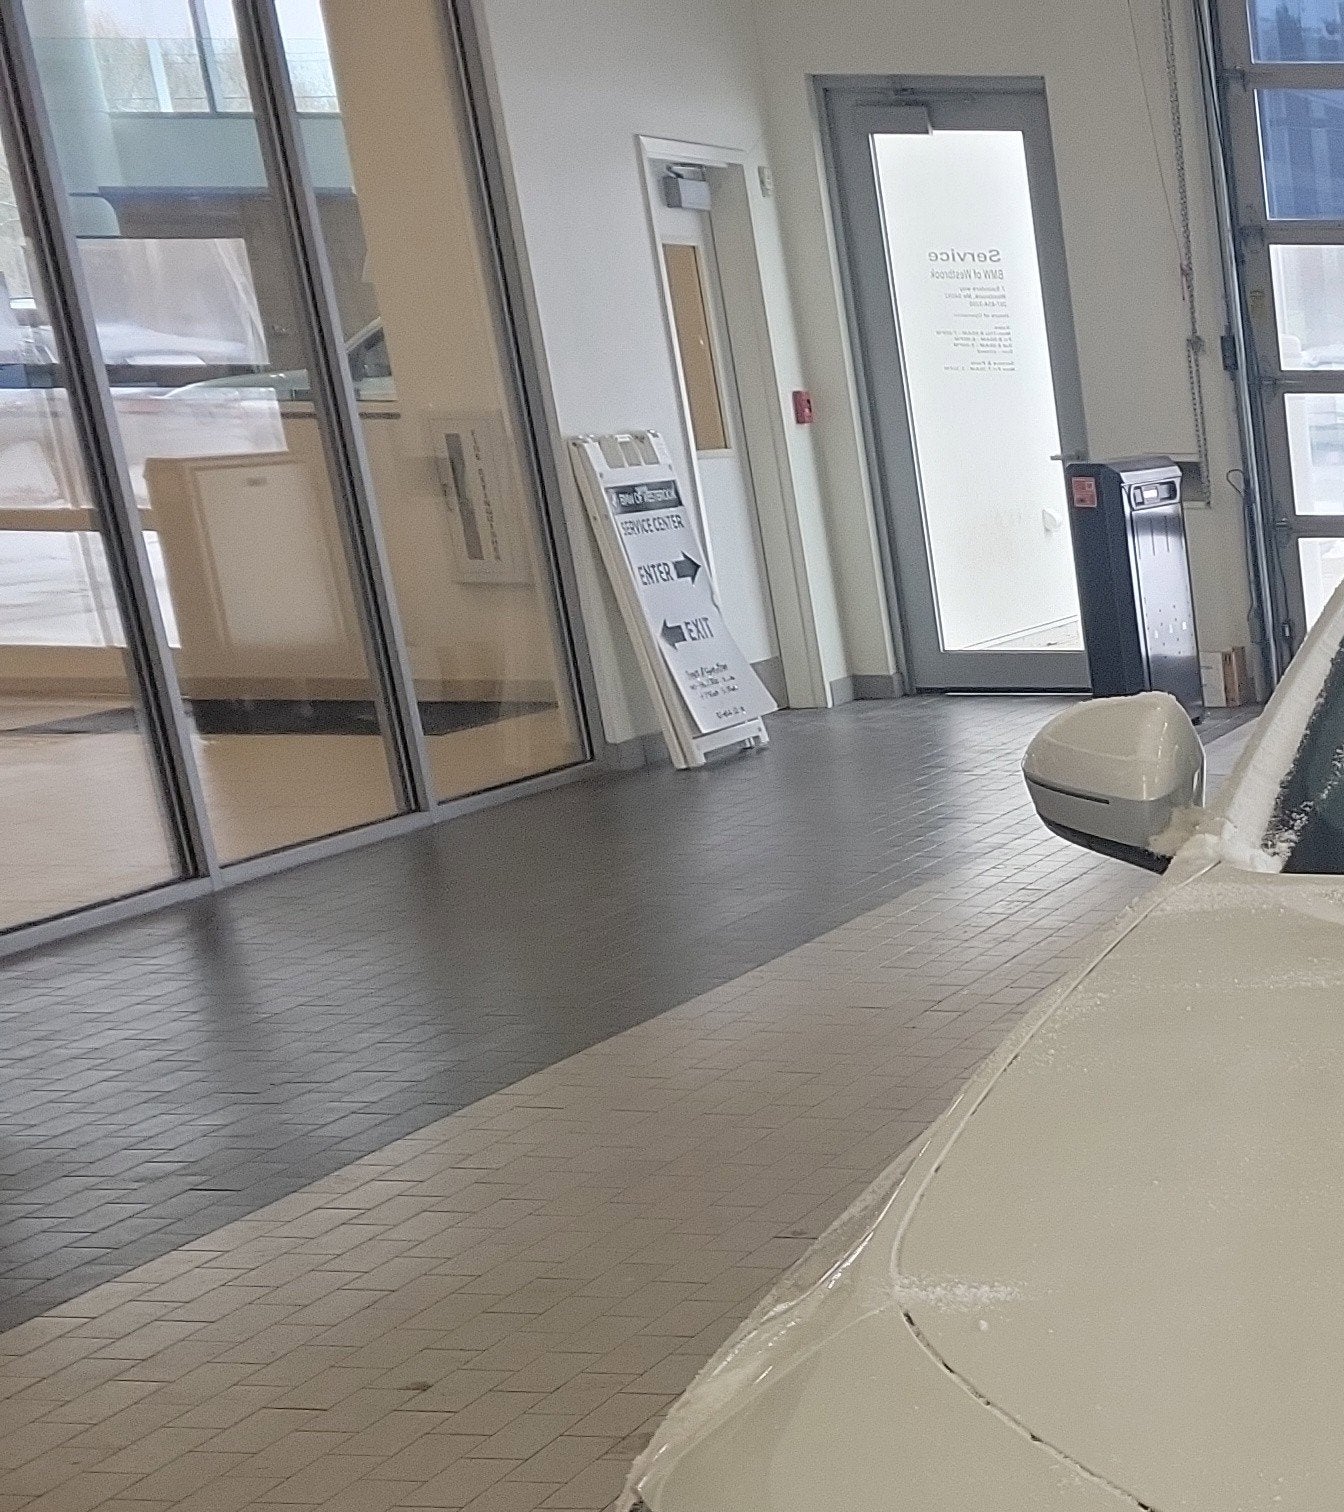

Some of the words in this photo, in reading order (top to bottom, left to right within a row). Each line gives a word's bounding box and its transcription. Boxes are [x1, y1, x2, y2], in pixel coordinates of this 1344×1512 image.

[620, 518, 653, 536] SERVICE
[652, 514, 685, 532] CENTER
[637, 562, 674, 586] ENTER
[684, 617, 714, 641] EXIT
